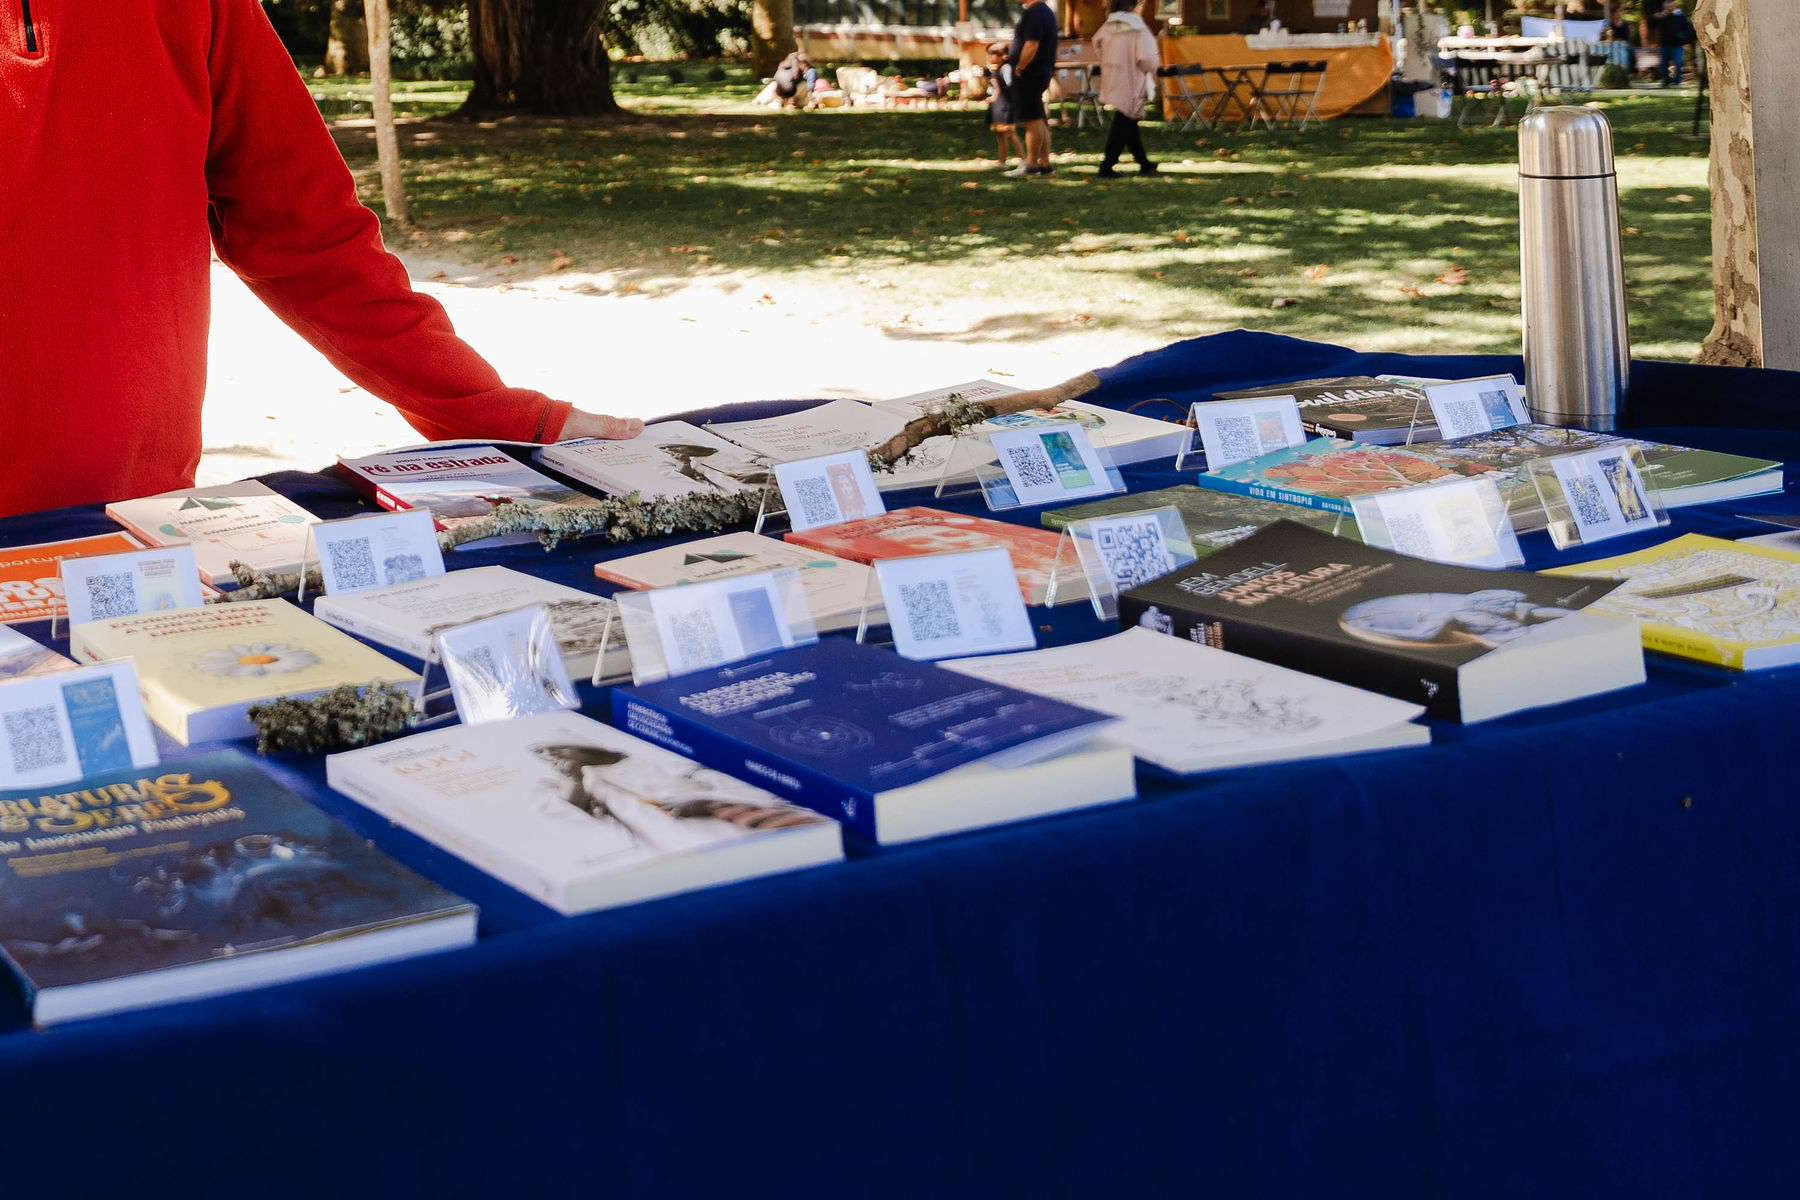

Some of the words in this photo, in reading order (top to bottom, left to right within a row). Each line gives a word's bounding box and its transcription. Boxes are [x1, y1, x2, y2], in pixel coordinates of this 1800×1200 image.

[1296, 388, 1426, 409] uilding
[360, 463, 390, 475] Pé
[394, 461, 423, 473] na
[426, 454, 510, 471] estrada
[1176, 572, 1219, 592] JEM
[1193, 562, 1288, 597] BENDELL
[1217, 569, 1296, 601] JUNTOS
